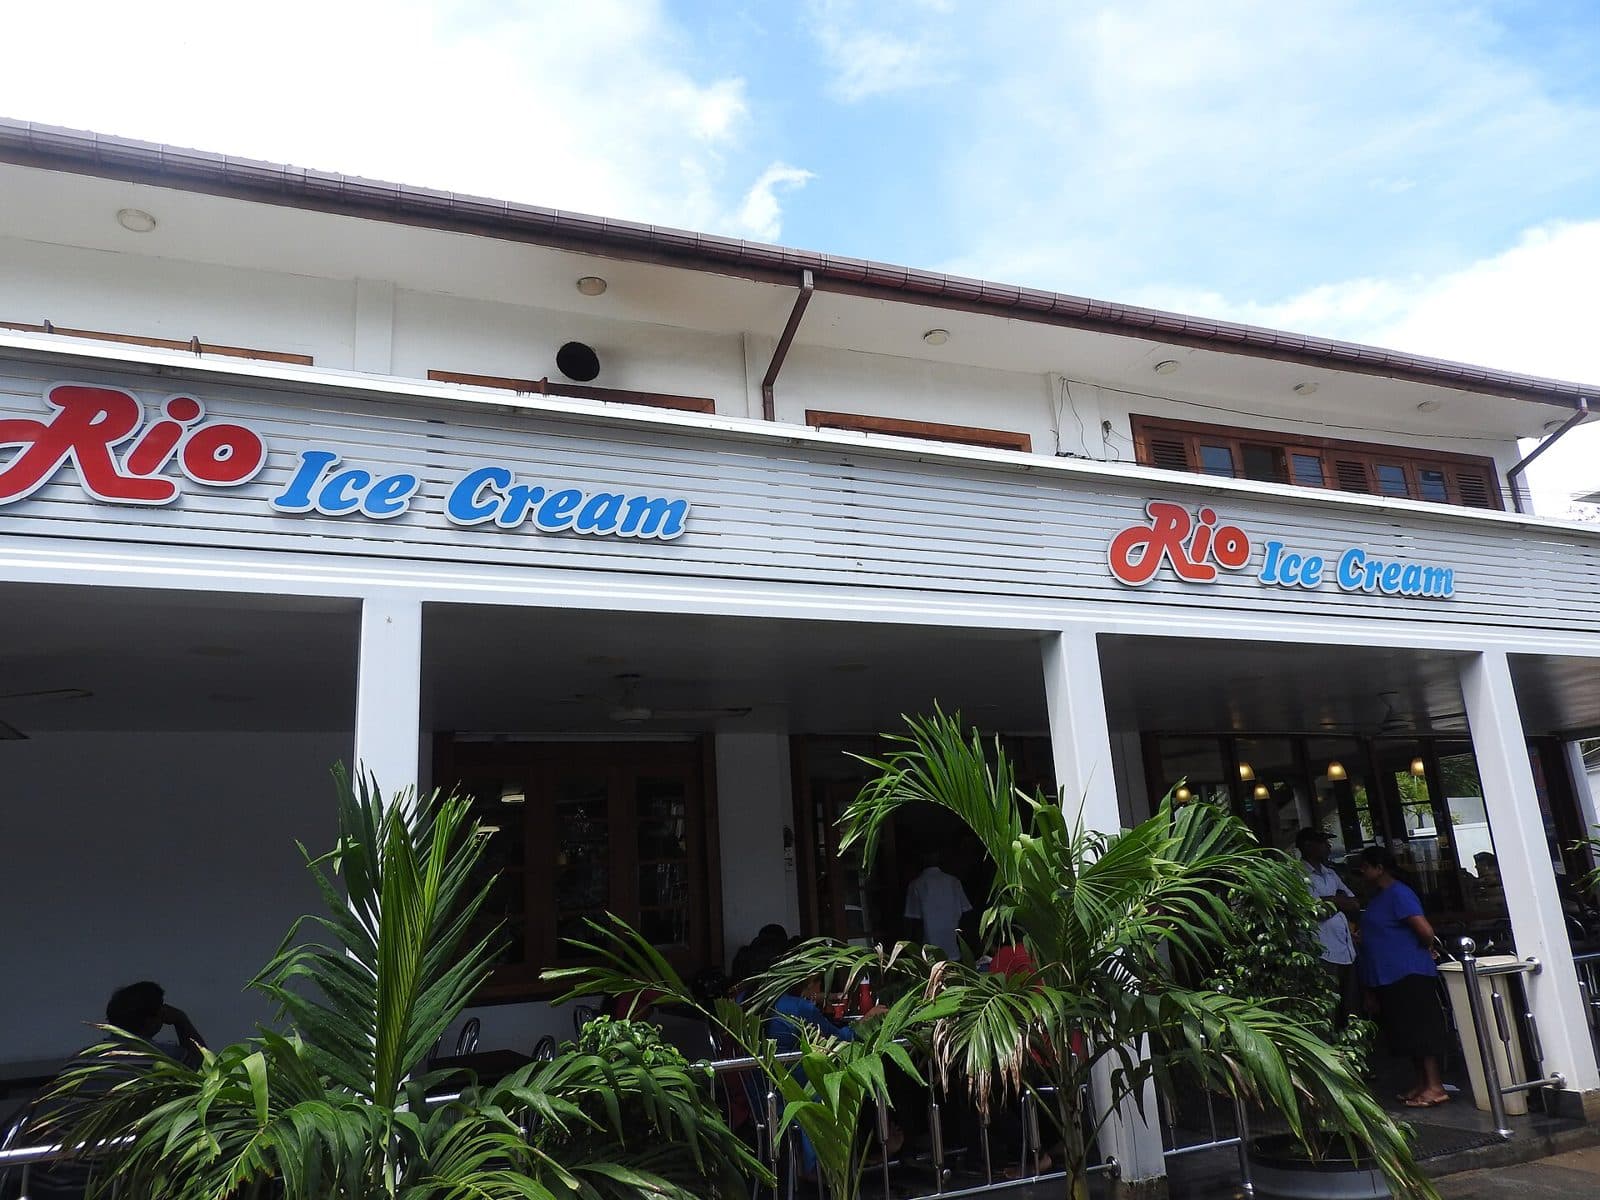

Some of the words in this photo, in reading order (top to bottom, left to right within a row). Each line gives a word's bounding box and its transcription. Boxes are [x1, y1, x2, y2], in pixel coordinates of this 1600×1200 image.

[0, 383, 266, 503] Rio
[273, 450, 418, 516] Ice
[445, 467, 690, 538] Cream
[1109, 501, 1250, 584] Rio
[1260, 541, 1323, 587] Ice
[1337, 548, 1455, 597] Cream
